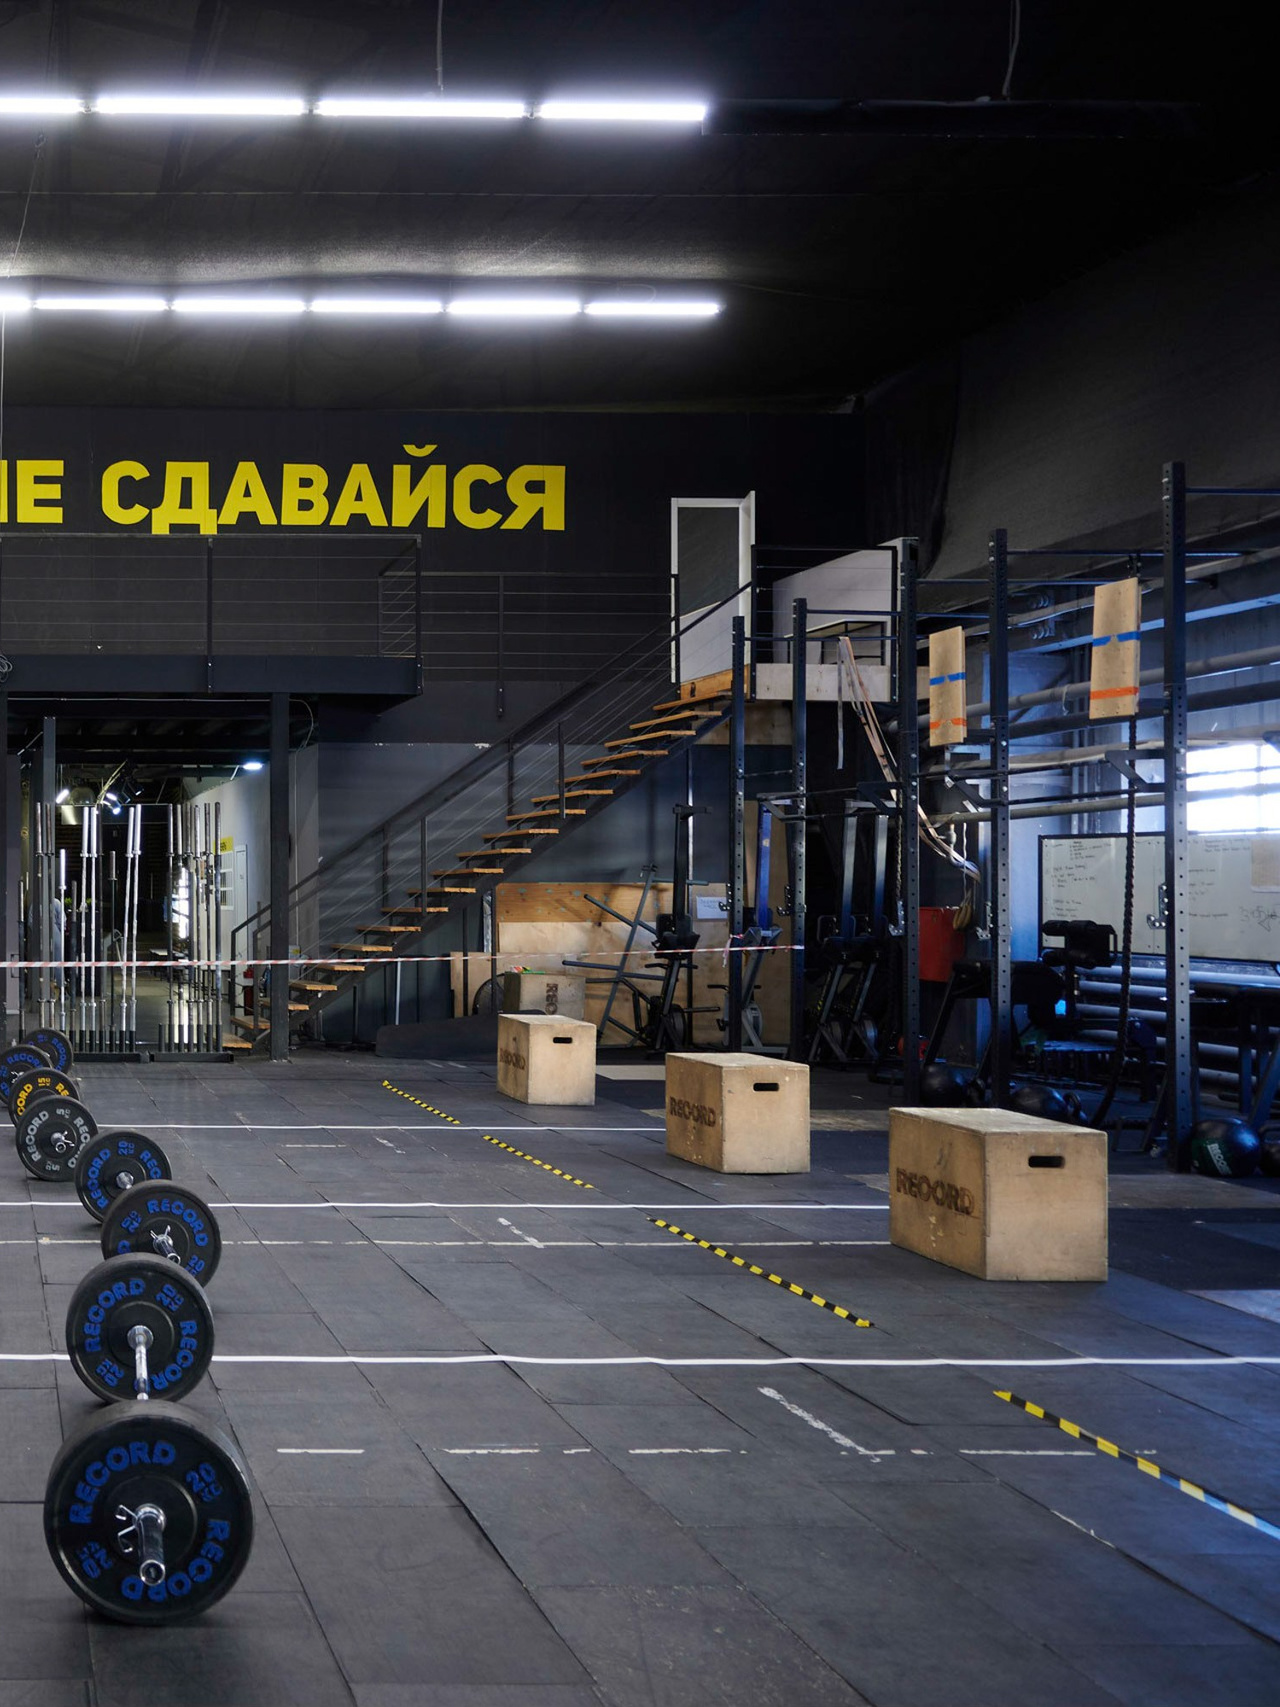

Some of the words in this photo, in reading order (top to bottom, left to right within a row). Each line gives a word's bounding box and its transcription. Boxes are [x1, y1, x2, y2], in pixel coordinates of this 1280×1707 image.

[102, 445, 566, 536] СДАВАЙСЯ
[25, 1110, 49, 1162] RECORD
[669, 1096, 717, 1127] RECORD
[87, 1148, 112, 1209] RECORD
[896, 1167, 975, 1216] RECORD
[147, 1198, 209, 1247] RECORD
[83, 1278, 146, 1352] RECORD
[68, 1440, 177, 1524] RECORD
[186, 1462, 216, 1494] 20
